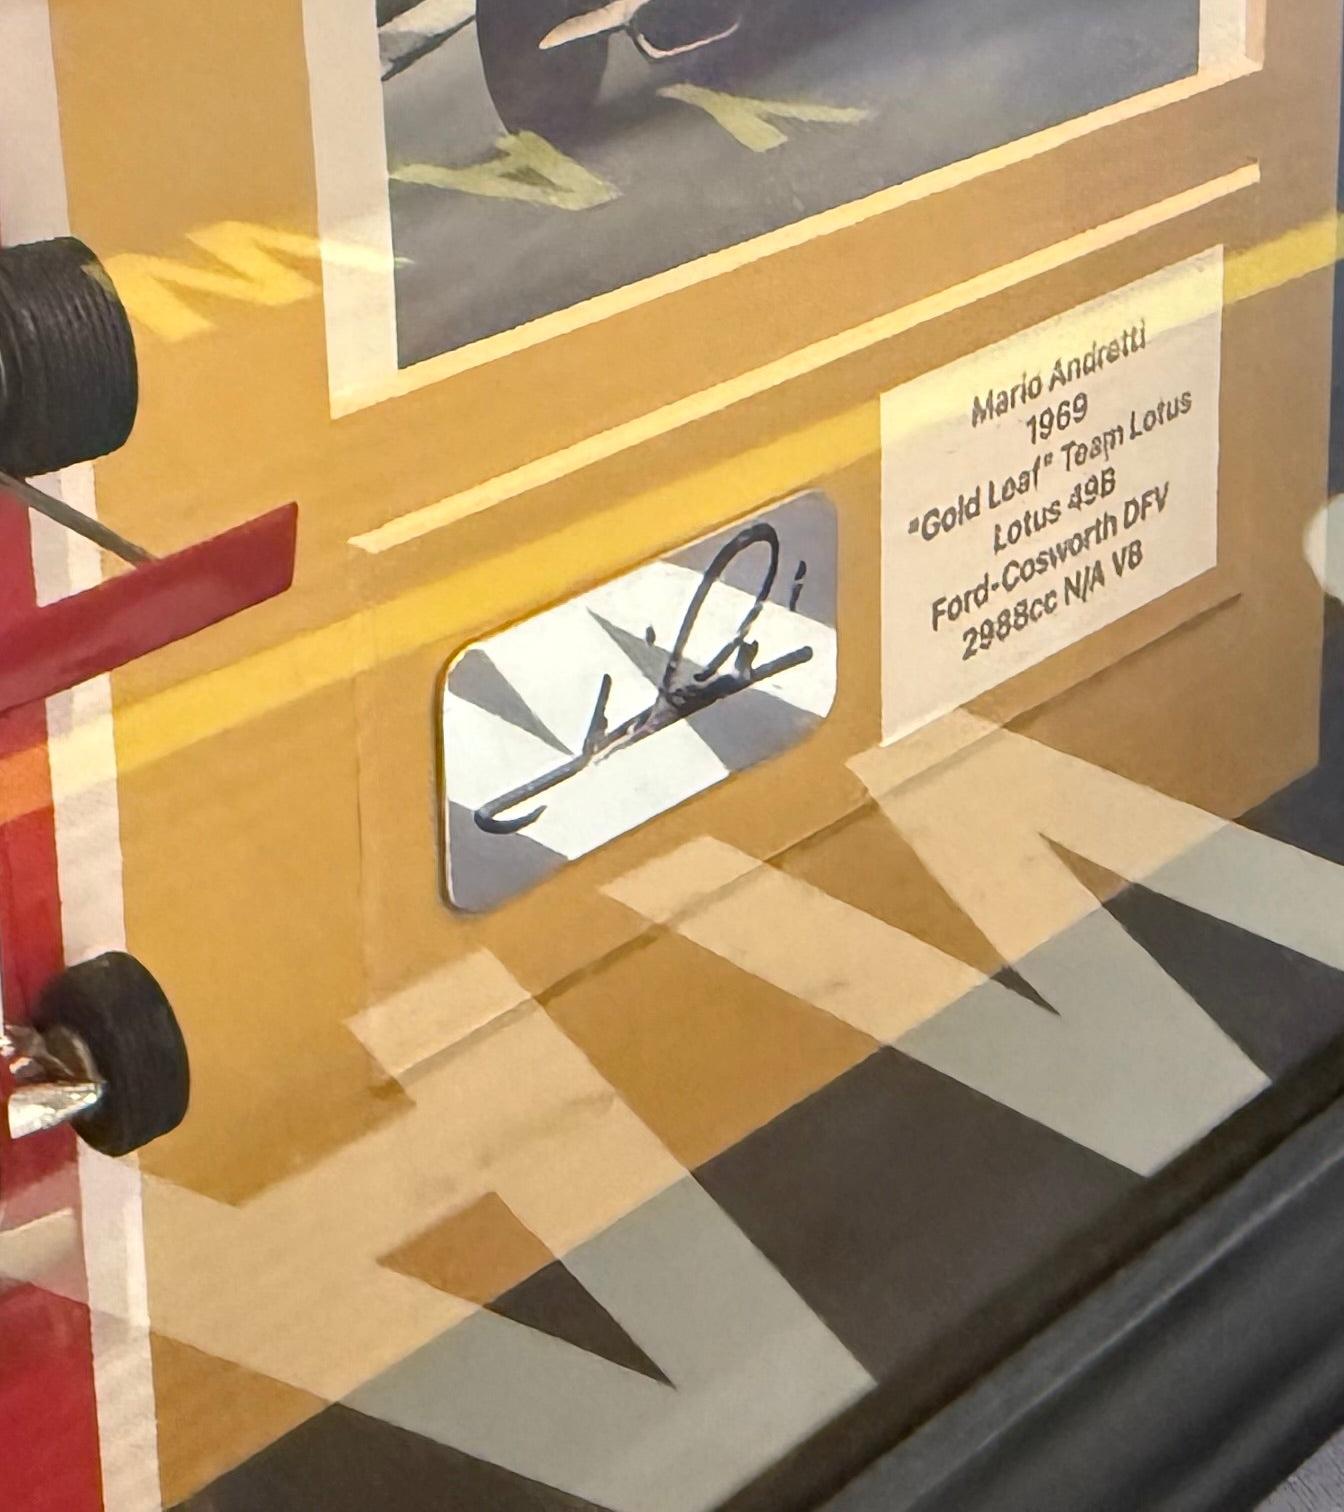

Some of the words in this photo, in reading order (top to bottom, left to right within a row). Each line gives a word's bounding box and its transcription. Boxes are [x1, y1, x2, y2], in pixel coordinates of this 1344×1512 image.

[970, 371, 1042, 428] Mario
[1047, 319, 1147, 393] Andretti
[1027, 392, 1088, 445] 1969
[907, 485, 981, 542] "Gold
[1060, 424, 1124, 472] Team
[1129, 390, 1192, 441] Lotus
[992, 500, 1062, 555] Lotus
[1067, 467, 1116, 512] 49B
[931, 511, 1118, 632] Ford-Cosworth
[1123, 481, 1170, 529] DFV
[962, 589, 1057, 661] 2988cc
[1064, 561, 1105, 606] N/A
